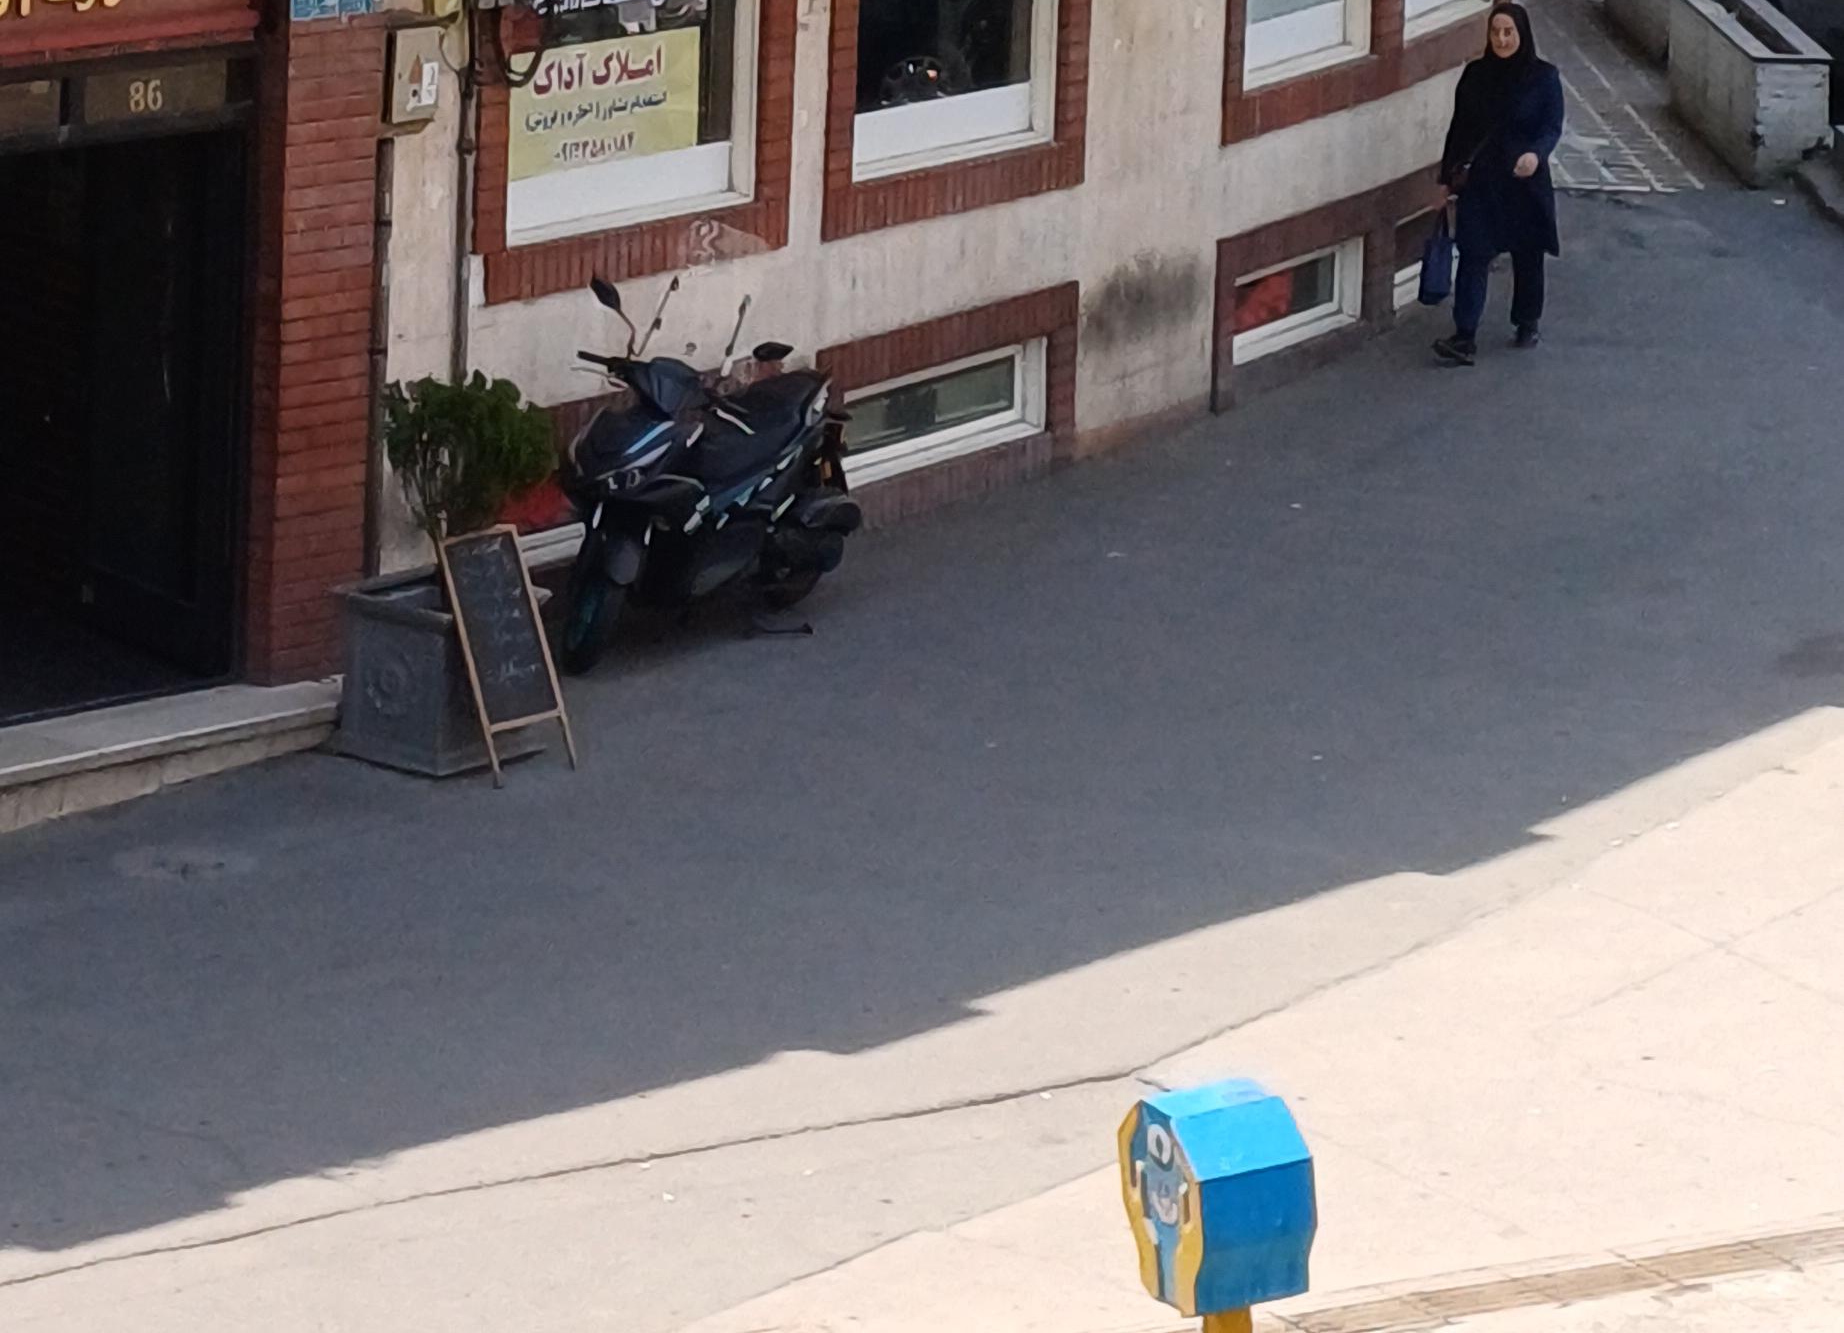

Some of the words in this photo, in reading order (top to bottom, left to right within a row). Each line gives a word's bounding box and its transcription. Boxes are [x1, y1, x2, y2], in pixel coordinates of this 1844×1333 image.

[533, 52, 588, 96] آداک
[592, 44, 662, 85] املاک
[129, 79, 164, 113] 86
